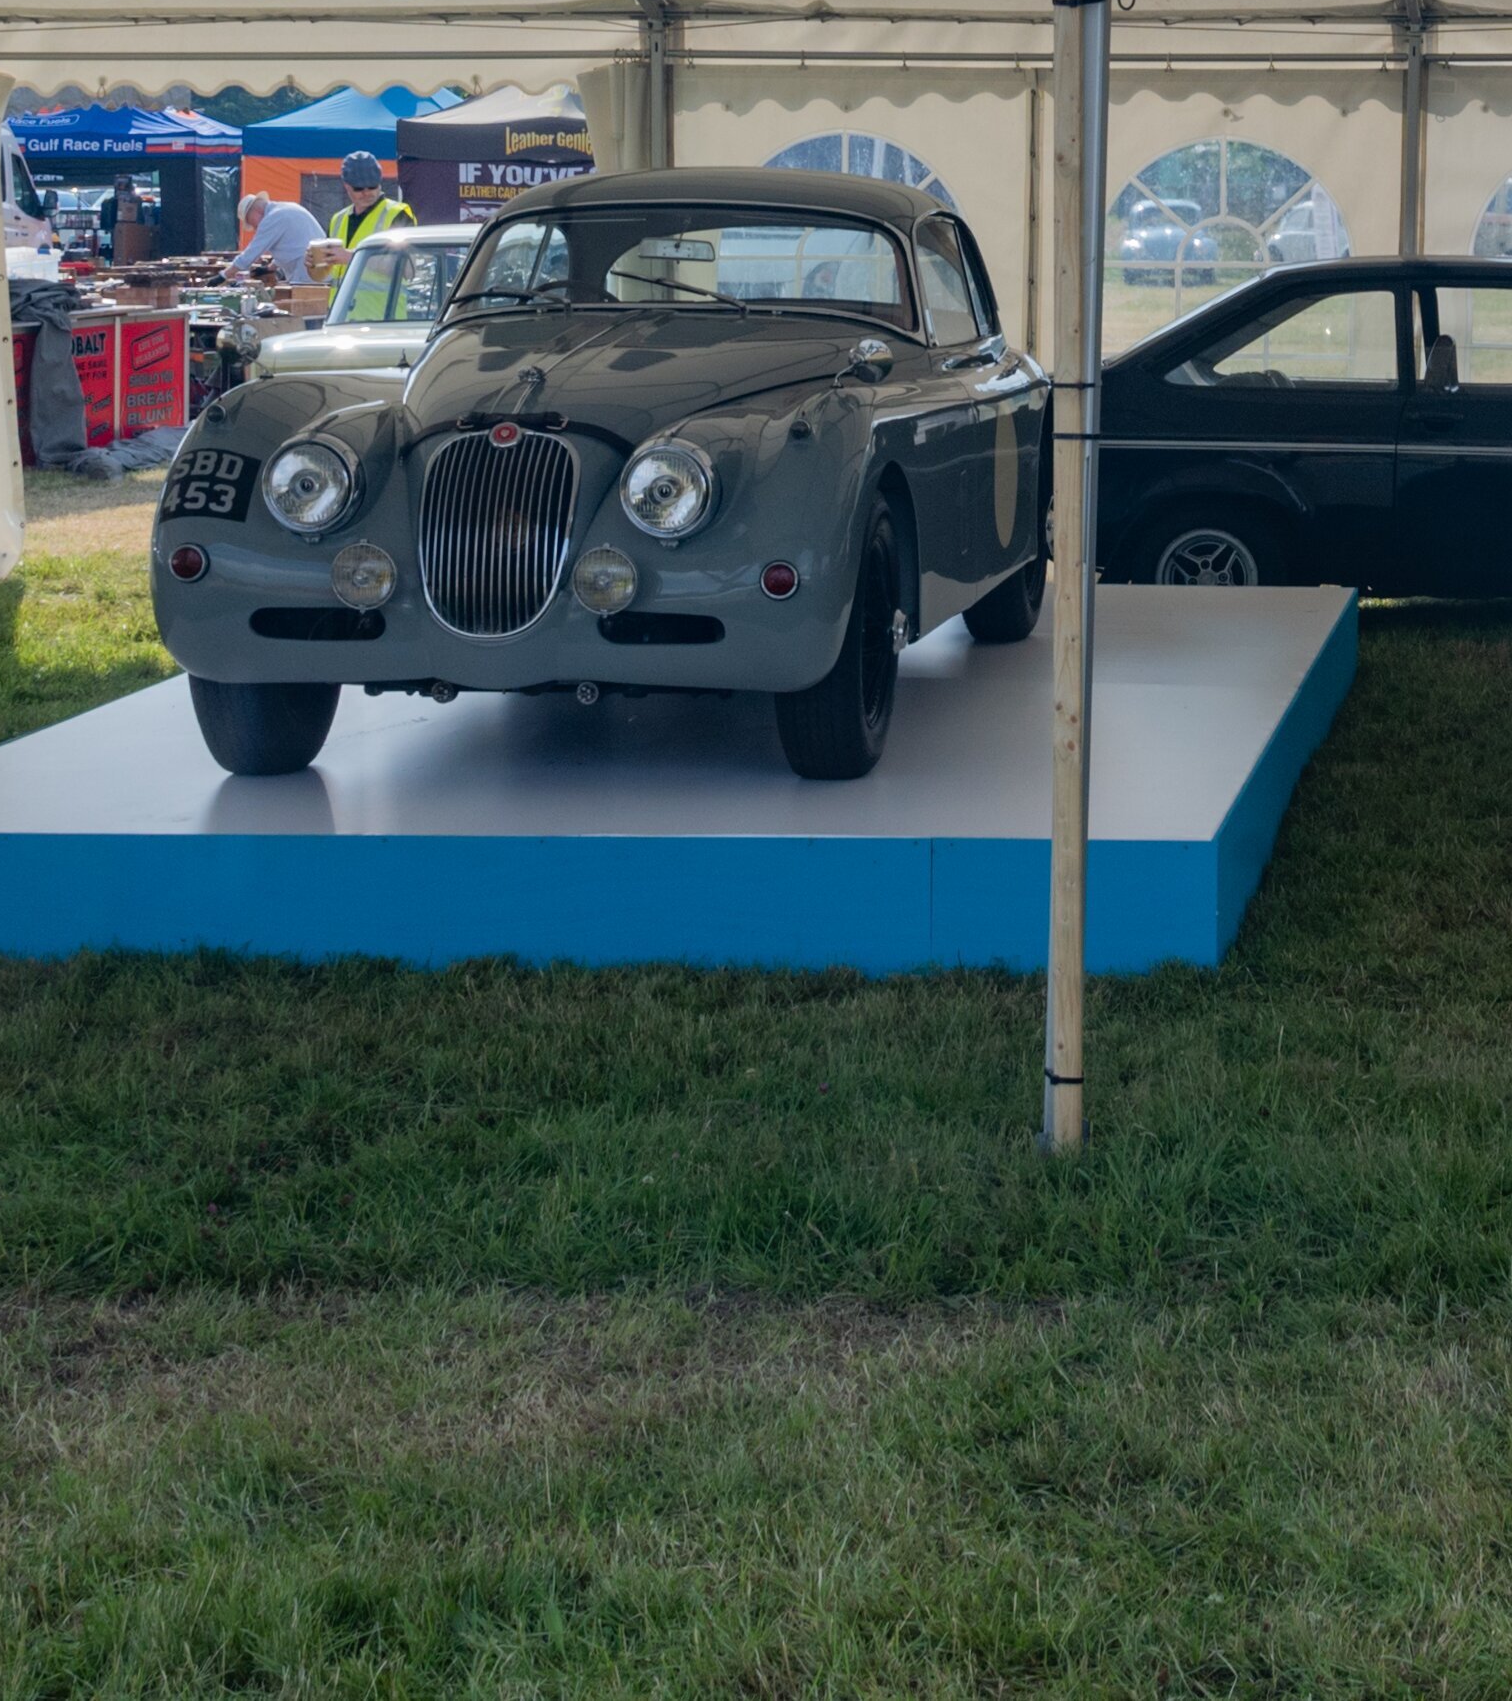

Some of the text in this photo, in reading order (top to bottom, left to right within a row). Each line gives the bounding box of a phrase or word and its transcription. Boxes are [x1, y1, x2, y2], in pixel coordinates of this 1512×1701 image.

[28, 138, 144, 152] Gulf Race Fuels
[505, 126, 593, 155] Leather Genie
[459, 163, 483, 184] IF
[459, 185, 497, 198] LEATHER
[127, 389, 176, 408] BREAK
[127, 406, 175, 426] BLUNT
[173, 451, 244, 481] SBD
[164, 481, 236, 514] 453
